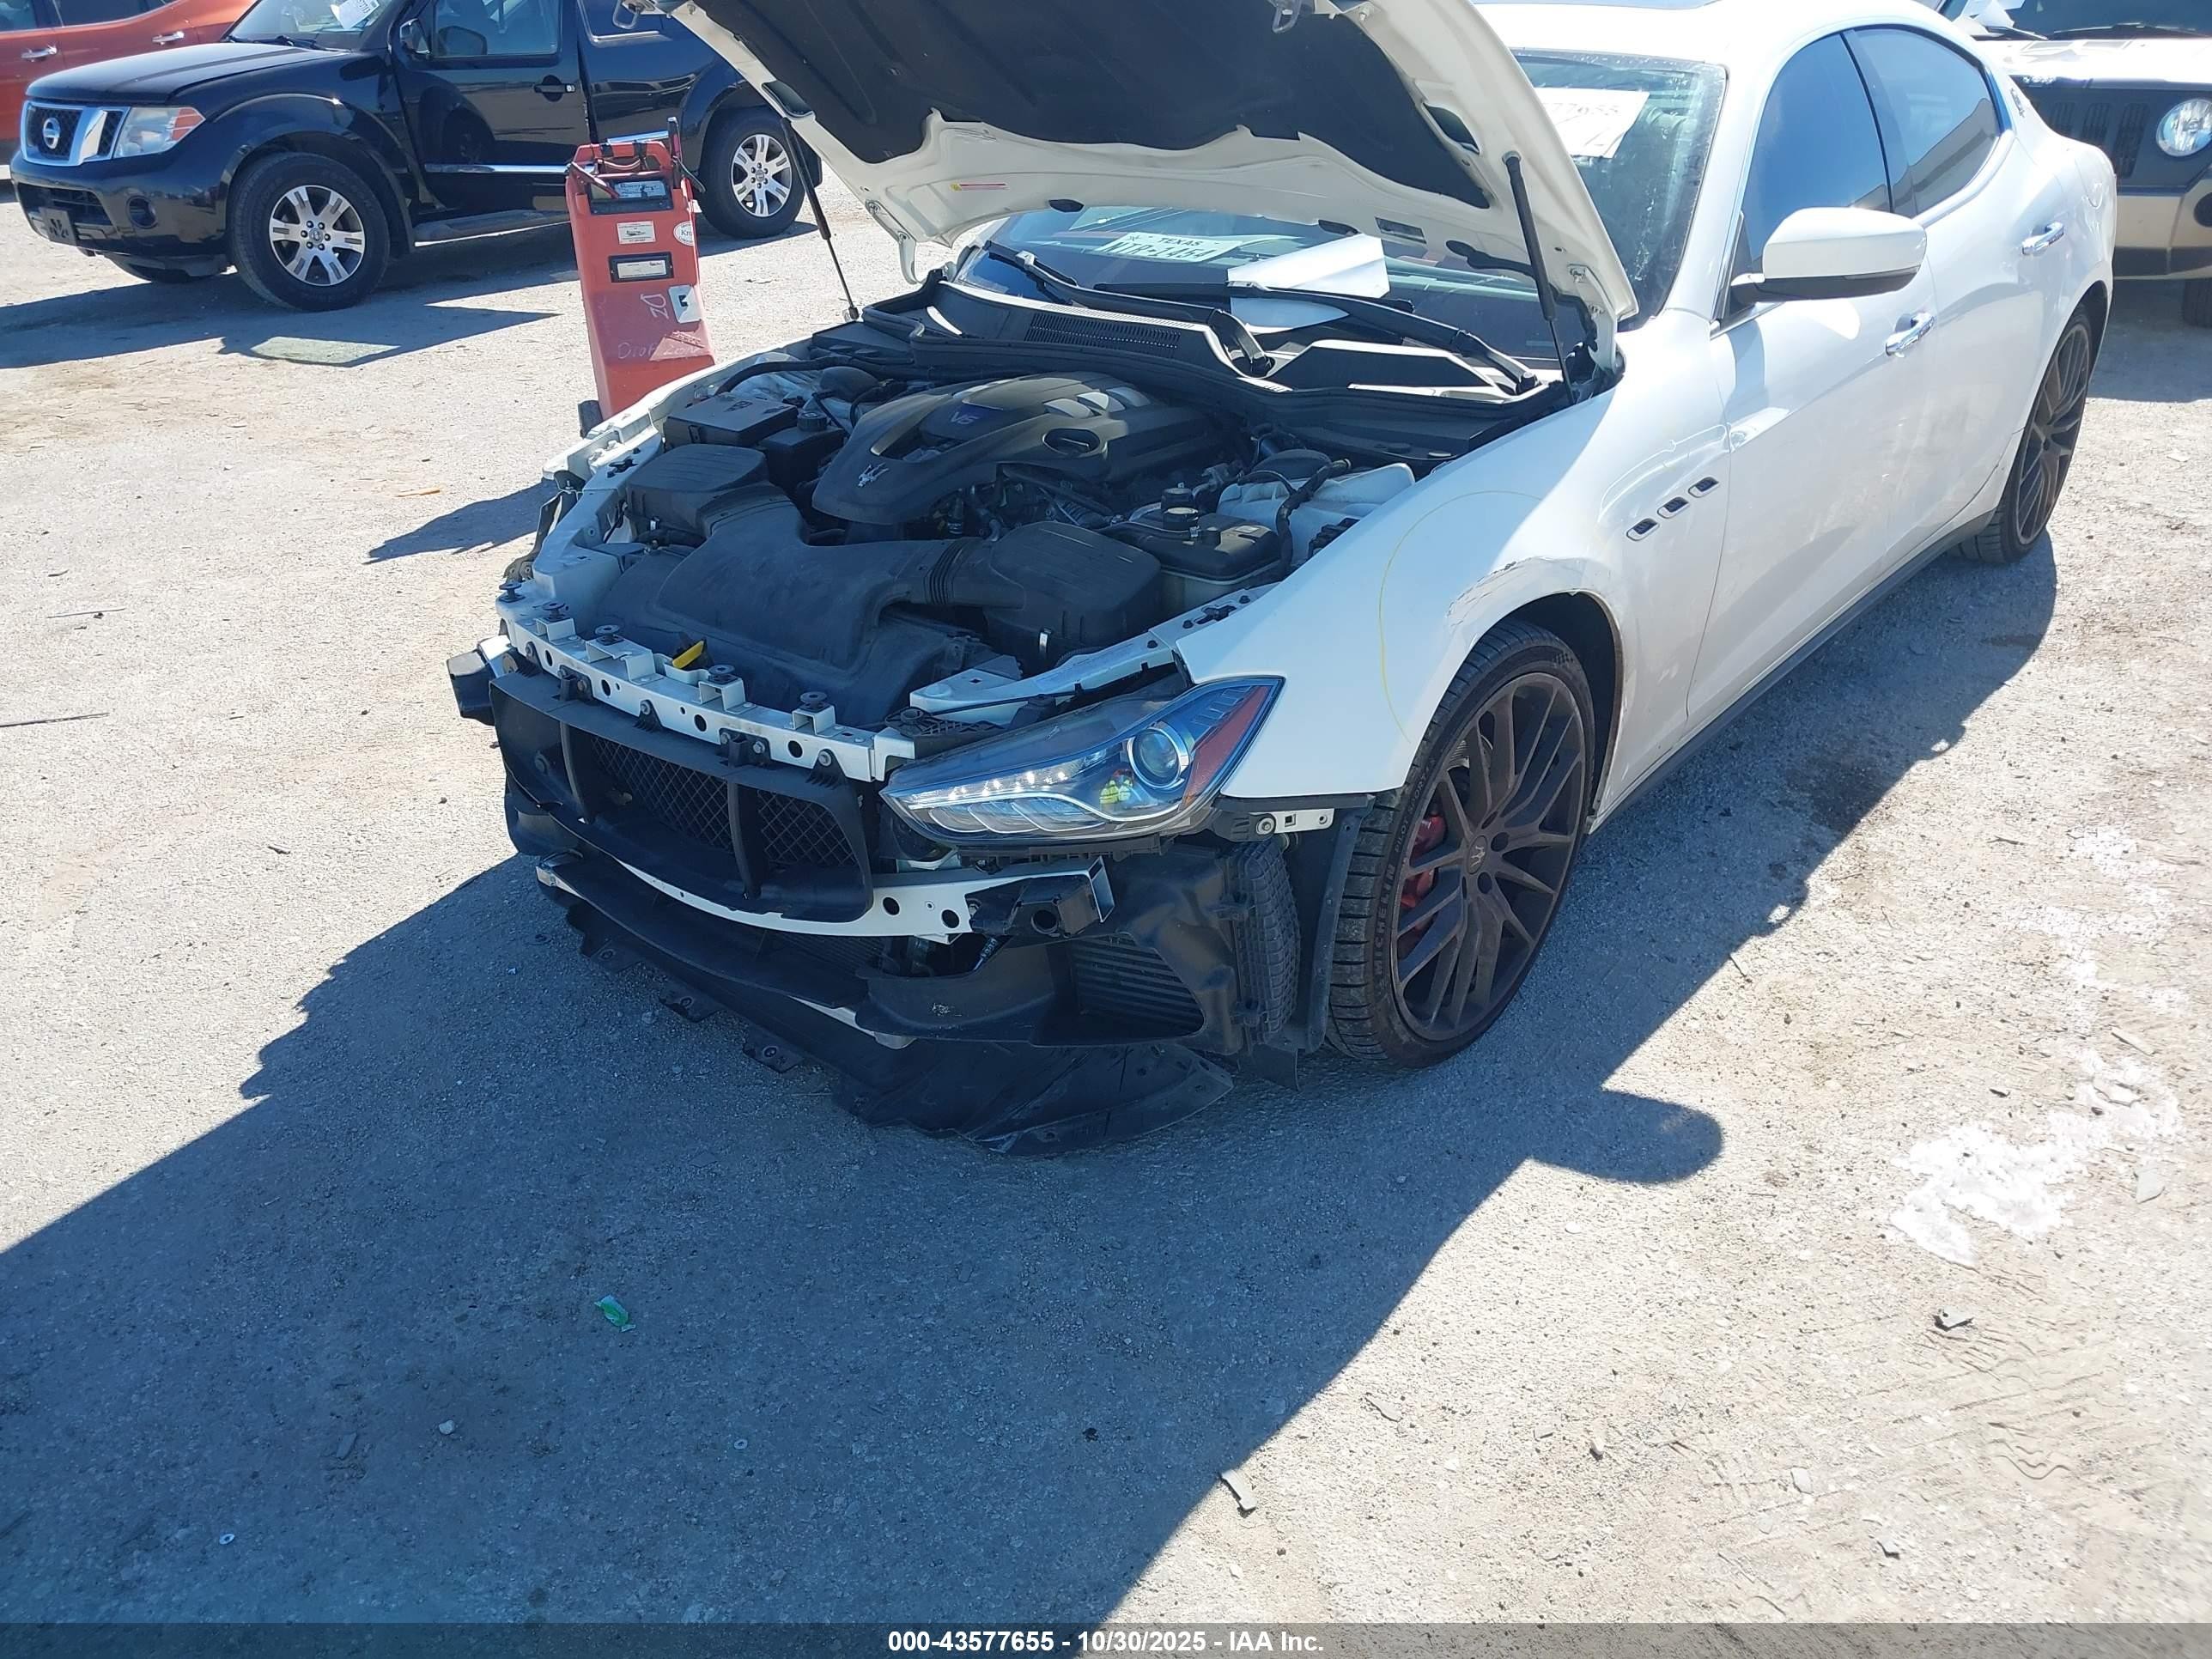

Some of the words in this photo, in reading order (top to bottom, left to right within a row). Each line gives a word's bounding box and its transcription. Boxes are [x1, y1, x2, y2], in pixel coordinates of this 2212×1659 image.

[1158, 237, 1204, 246] TEXAS
[949, 411, 979, 425] V6
[1374, 863, 1396, 975] MICHELIN
